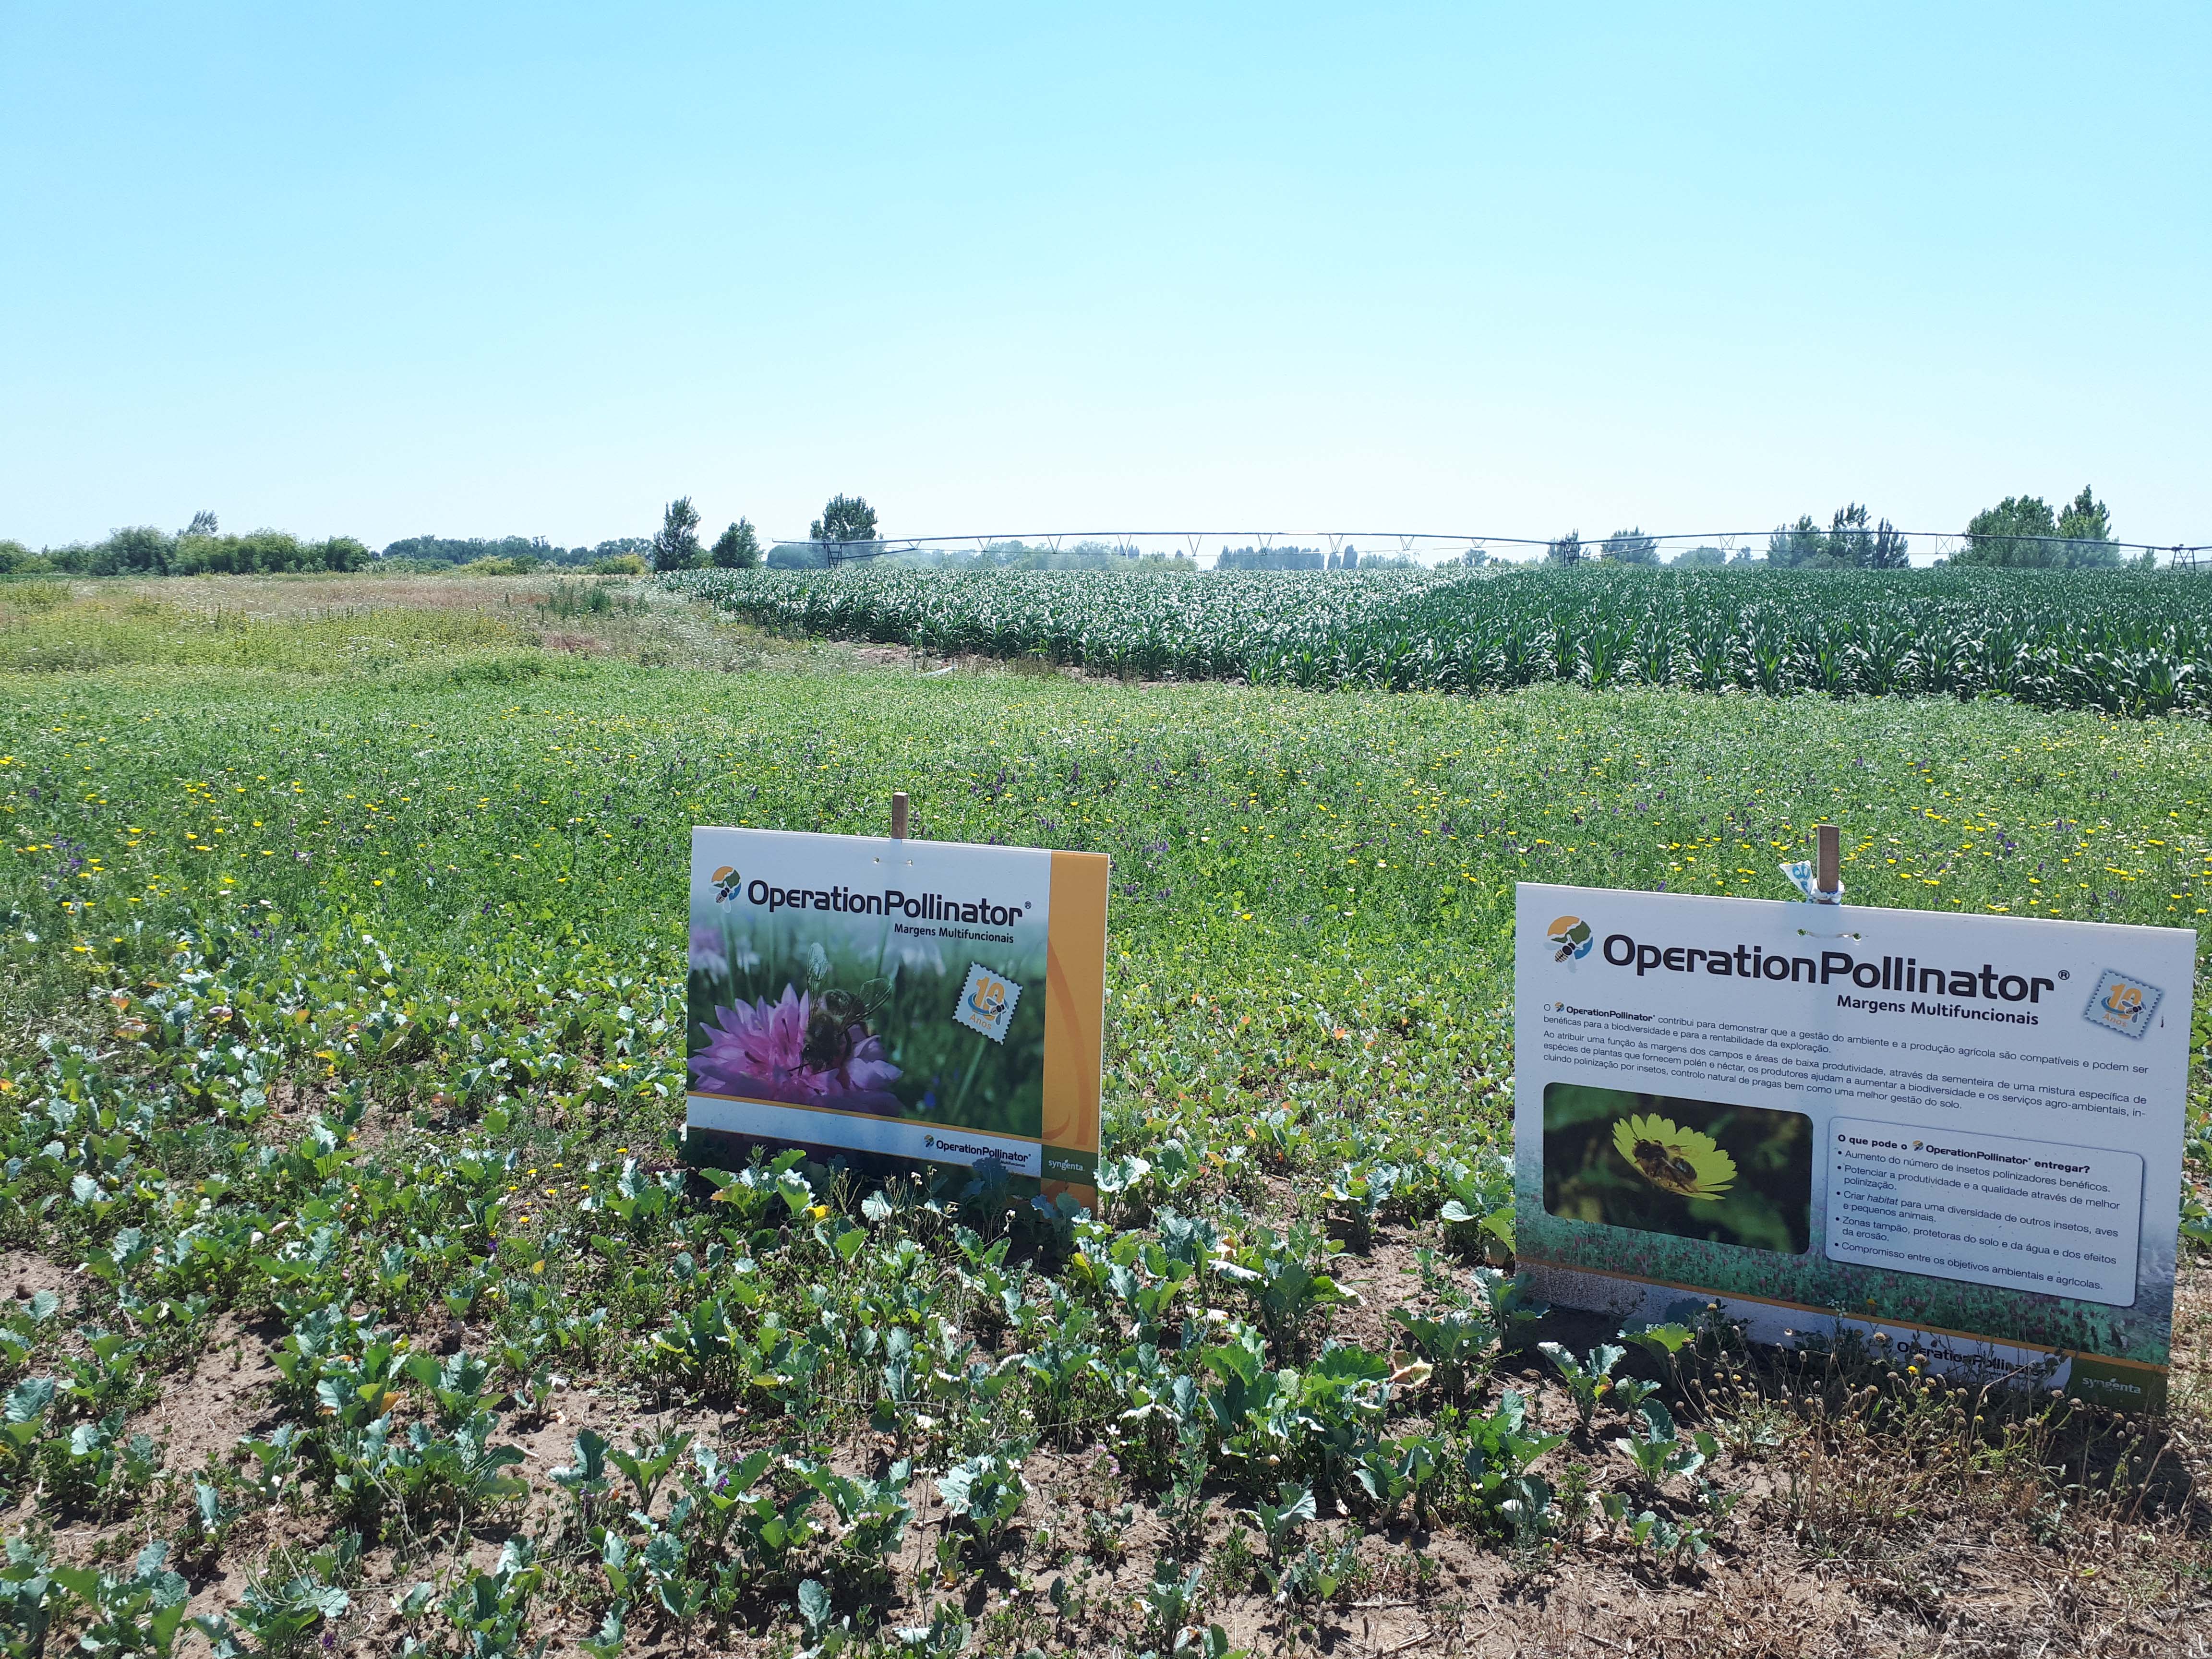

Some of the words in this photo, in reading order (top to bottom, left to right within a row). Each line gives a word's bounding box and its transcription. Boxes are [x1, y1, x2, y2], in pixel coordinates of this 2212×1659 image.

[894, 923, 936, 938] Margens
[938, 927, 1014, 943] Multifuncionais
[969, 1014, 992, 1030] Anos
[1837, 994, 1906, 1014] Margens
[1911, 1000, 2039, 1025] Multifuncionais
[2103, 1013, 2128, 1028] Anos
[1543, 1003, 1551, 1011] O
[1658, 1017, 1694, 1027] contribui
[1696, 1021, 1716, 1029] para
[1719, 1022, 1768, 1034] demonstrar
[1771, 1028, 1788, 1037] que
[1832, 1033, 1844, 1042] do
[1847, 1036, 1889, 1047] ambiente
[2092, 1061, 2129, 1072] podem
[2132, 1066, 2149, 1074] ser
[1584, 1021, 1602, 1029] para
[1611, 1022, 1671, 1036] biodiversidade
[1680, 1031, 1699, 1039] para
[1709, 1034, 1764, 1046] rentabilidade
[1766, 1039, 1778, 1048] da
[1543, 1030, 1555, 1038] Ao
[1557, 1032, 1585, 1042] atribuir
[1651, 1043, 1687, 1054] margens
[1690, 1046, 1706, 1056] dos
[1708, 1049, 1743, 1060] campos
[1781, 1057, 1793, 1065] de
[1796, 1058, 1819, 1068] baixa
[1822, 1062, 1886, 1077] produtividade,
[1926, 1072, 1938, 1082] da
[1941, 1075, 1994, 1088] sementeira
[1997, 1080, 2010, 1089] de
[2013, 1083, 2035, 1092] uma
[2038, 1085, 2076, 1097] mistura
[2133, 1095, 2147, 1105] de
[1543, 1053, 1572, 1063] cluindo
[1637, 1063, 1668, 1076] insetos,
[1671, 1069, 1705, 1080] controlo
[1707, 1073, 1736, 1083] natural
[1738, 1076, 1750, 1085] de
[1752, 1079, 1782, 1089] pragas
[1784, 1081, 1804, 1091] bem
[1806, 1085, 1832, 1094] como
[1834, 1088, 1854, 1097] uma
[1857, 1090, 1888, 1100] melhor
[1924, 1097, 1937, 1106] do
[1939, 1100, 1962, 1109] solo.
[1580, 1046, 1591, 1054] de
[1593, 1047, 1623, 1058] plantas
[1624, 1052, 1640, 1060] que
[1642, 1052, 1682, 1065] fornecem
[1748, 1066, 1759, 1074] os
[1761, 1068, 1809, 1080] produtores
[1811, 1072, 1843, 1083] ajudam
[1854, 1078, 1898, 1089] aumentar
[1908, 1082, 1976, 1098] biodiversidade
[1987, 1093, 1999, 1101] os
[2045, 1099, 2129, 1117] agro-ambientais,
[1048, 1159, 1083, 1171] syngenta
[1838, 1134, 1846, 1142] O
[1849, 1137, 1869, 1146] que
[1871, 1140, 1898, 1149] pode
[2034, 1160, 2091, 1174] entregar?
[1845, 1150, 1886, 1163] Aumento
[1888, 1155, 1901, 1165] do
[1941, 1163, 1954, 1172] de
[1956, 1164, 1990, 1177] insetos
[1993, 1170, 2057, 1186] polinizadores
[1844, 1164, 1887, 1178] Potenciar
[1898, 1173, 1961, 1188] produtividade
[1981, 1184, 2029, 1197] qualidade
[2069, 1195, 2083, 1205] de
[2085, 1199, 2120, 1210] melhor
[1843, 1190, 1865, 1201] Criar
[1867, 1193, 1899, 1206] habitat
[1900, 1200, 1922, 1209] para
[1924, 1203, 1945, 1213] uma
[1947, 1205, 2002, 1221] diversidade
[2004, 1213, 2017, 1223] de
[2020, 1217, 2051, 1227] outros
[2054, 1220, 2092, 1235] insetos,
[2095, 1227, 2118, 1238] aves
[1851, 1204, 1896, 1216] pequenos
[1899, 1211, 1936, 1223] animais.
[1842, 1227, 1854, 1237] da
[1842, 1215, 1871, 1228] Zonas
[1913, 1228, 1961, 1241] protetoras
[1963, 1234, 1977, 1244] do
[1979, 1238, 1999, 1247] solo
[2010, 1241, 2023, 1251] da
[2062, 1249, 2081, 1259] dos
[2083, 1252, 2116, 1264] efeitos
[1841, 1241, 1905, 1259] Compromisso
[1907, 1253, 1931, 1263] entre
[1933, 1257, 1945, 1265] os
[1947, 1258, 1989, 1273] objetivos
[1992, 1266, 2044, 1281] ambientais
[2082, 1377, 2141, 1394] syngenta
